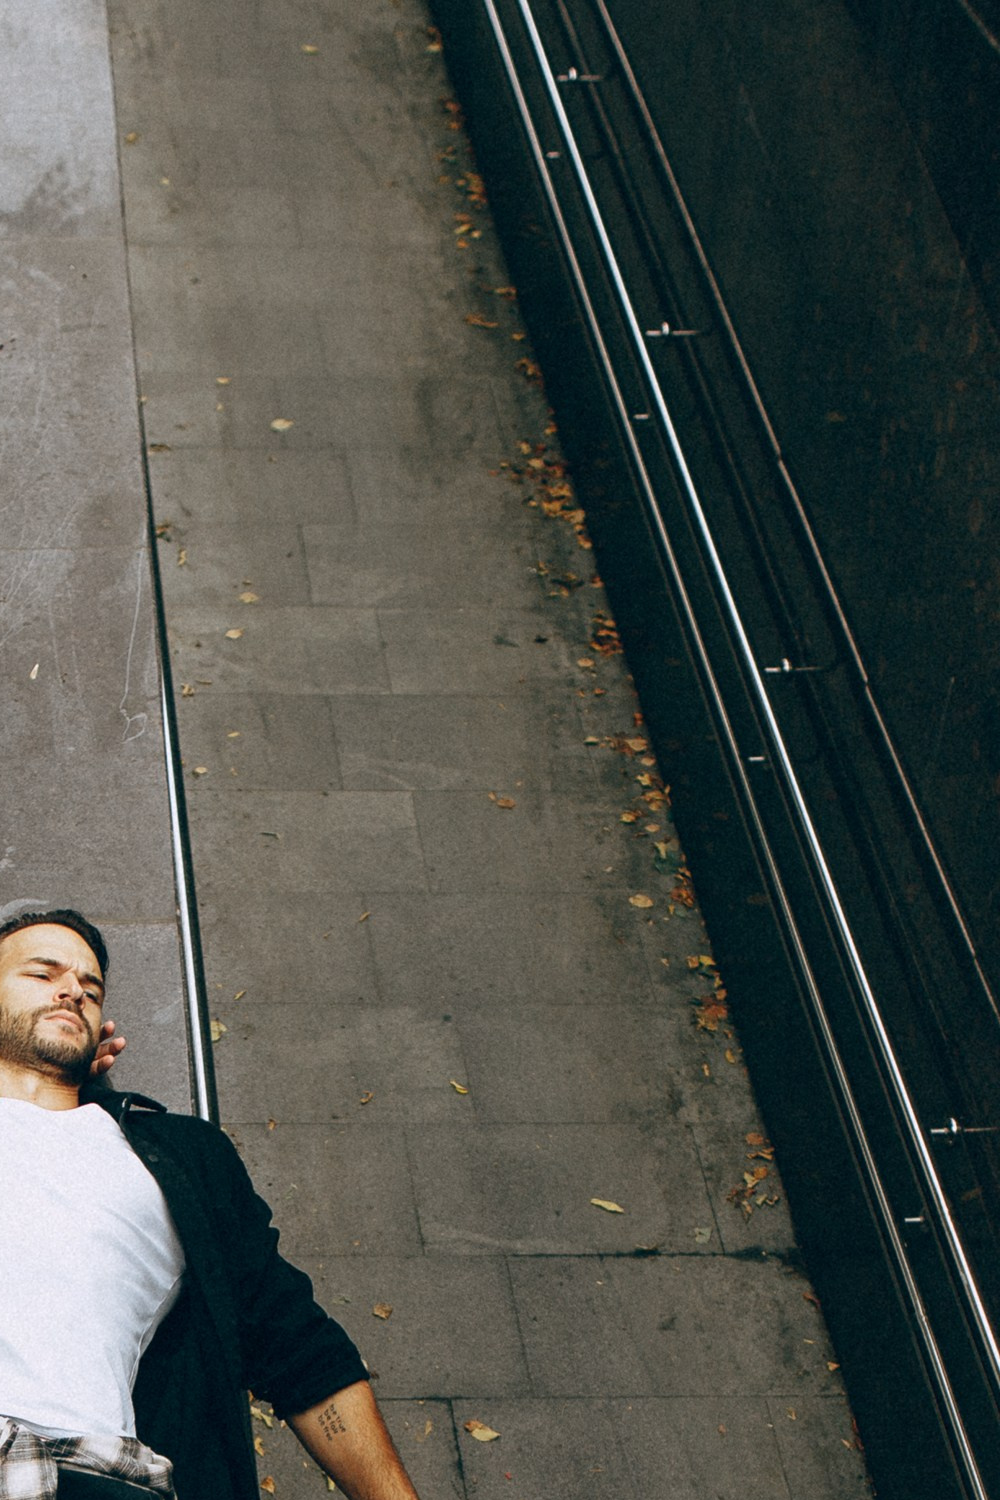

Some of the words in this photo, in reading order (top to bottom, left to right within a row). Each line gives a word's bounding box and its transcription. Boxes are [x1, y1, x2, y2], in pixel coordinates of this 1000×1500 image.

[318, 1415, 325, 1426] be
[324, 1409, 331, 1421] be
[330, 1404, 337, 1415] be
[336, 1416, 346, 1433] true
